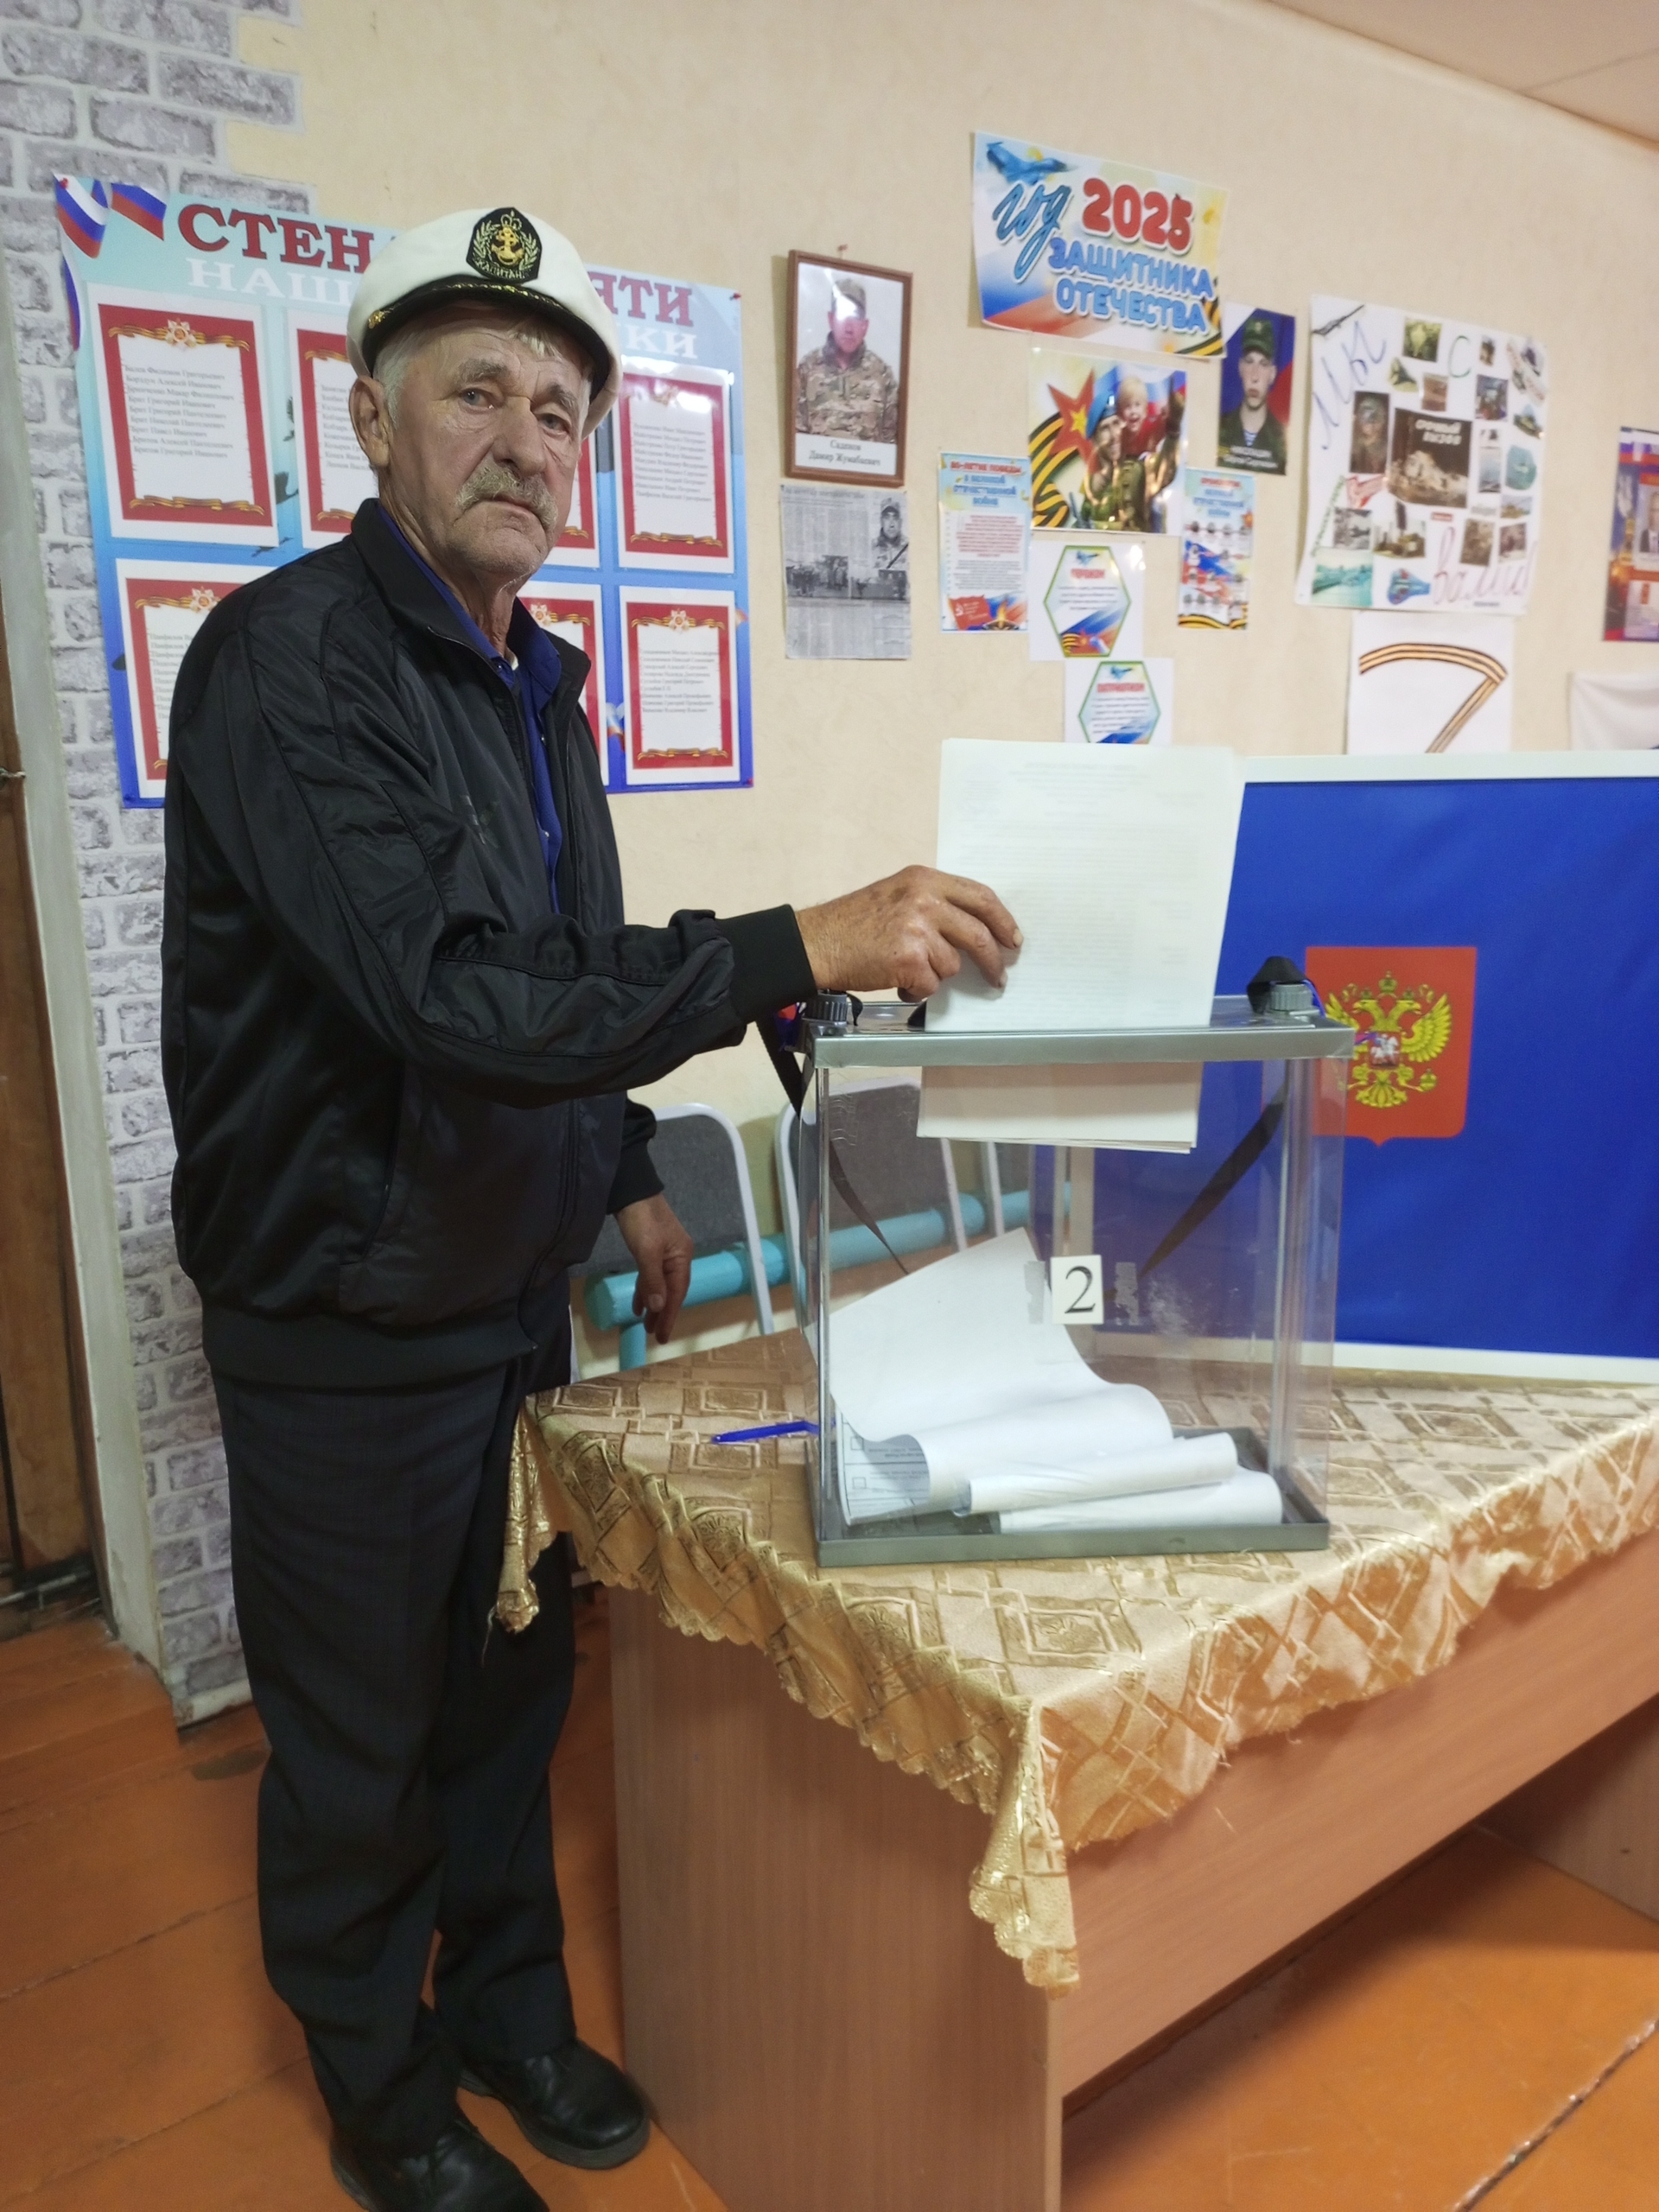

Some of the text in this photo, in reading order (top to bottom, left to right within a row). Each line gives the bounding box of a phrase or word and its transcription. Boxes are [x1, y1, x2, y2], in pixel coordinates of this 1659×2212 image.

[1083, 177, 1193, 251] 2025
[178, 203, 694, 327] СТЕН ЯТИ
[186, 257, 353, 304] НАШ
[1048, 237, 1213, 298] ЗАЩИТНИКА
[1056, 277, 1206, 333] ОТЕЧЕСТВА
[1064, 1265, 1096, 1314] 2
